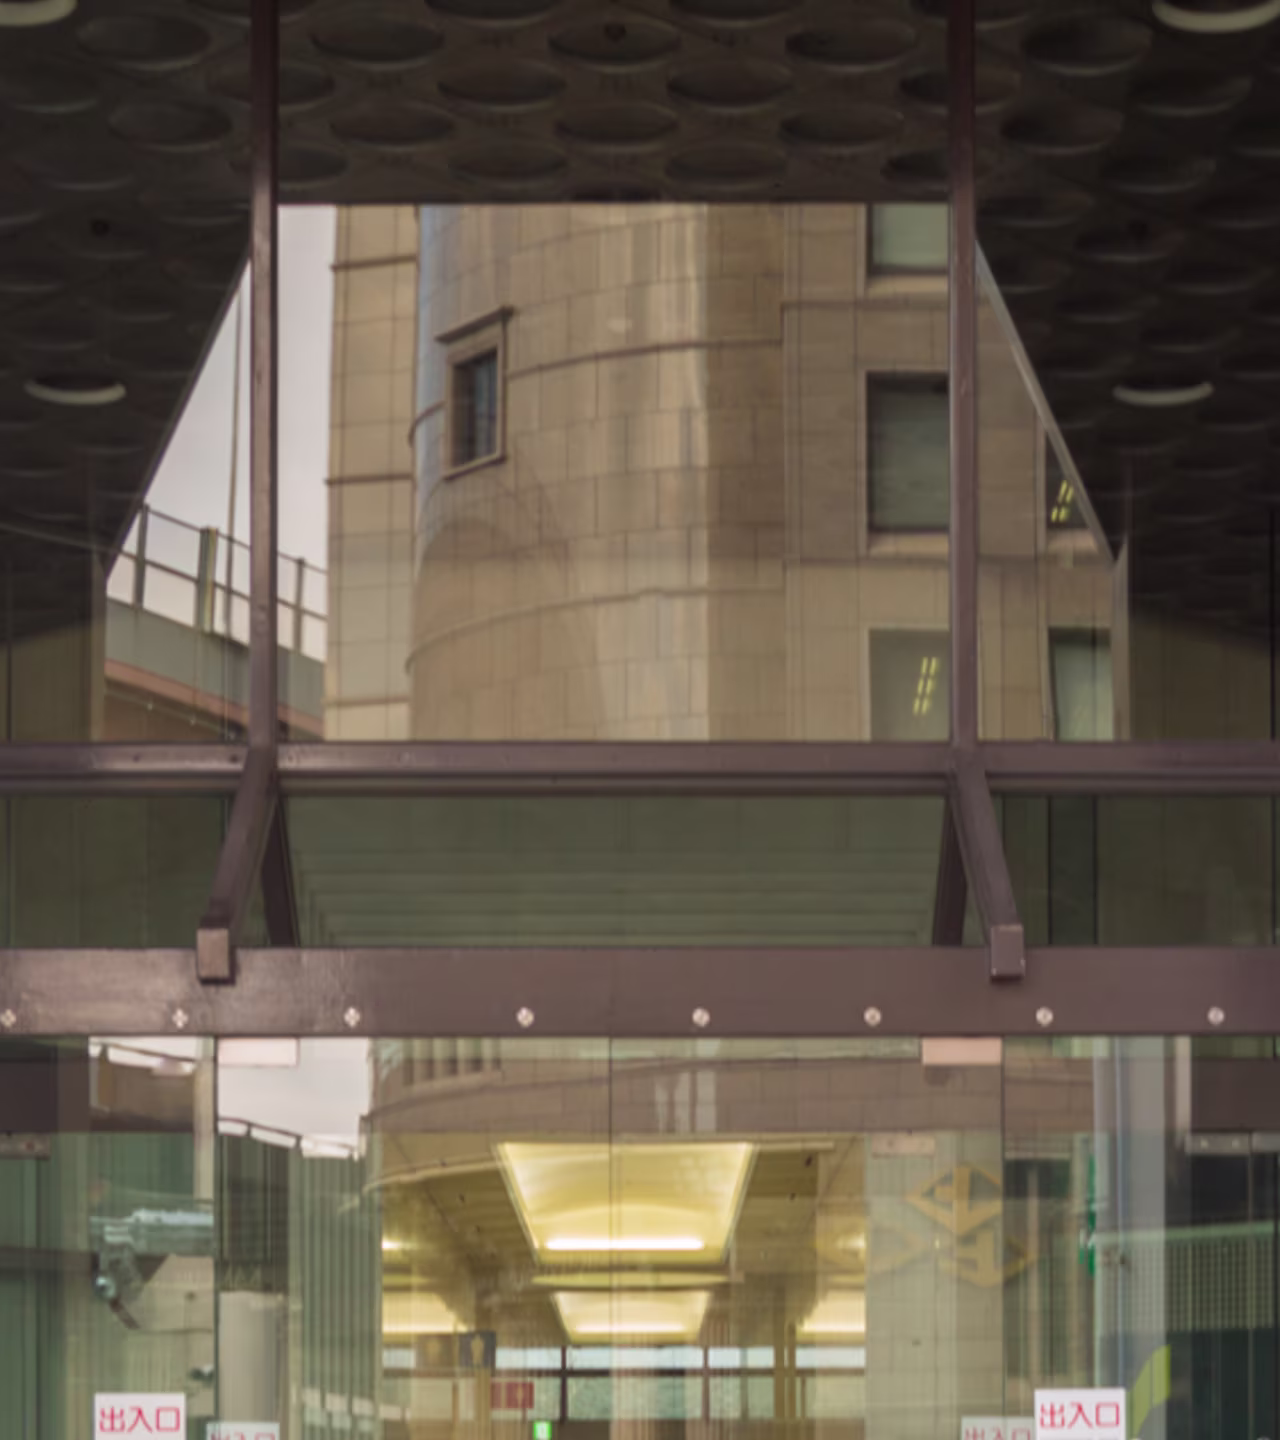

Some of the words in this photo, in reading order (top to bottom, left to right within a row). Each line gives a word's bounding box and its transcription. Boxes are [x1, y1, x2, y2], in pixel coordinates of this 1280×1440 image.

[99, 1406, 180, 1433] 出入口
[1040, 1401, 1120, 1429] 出入口
